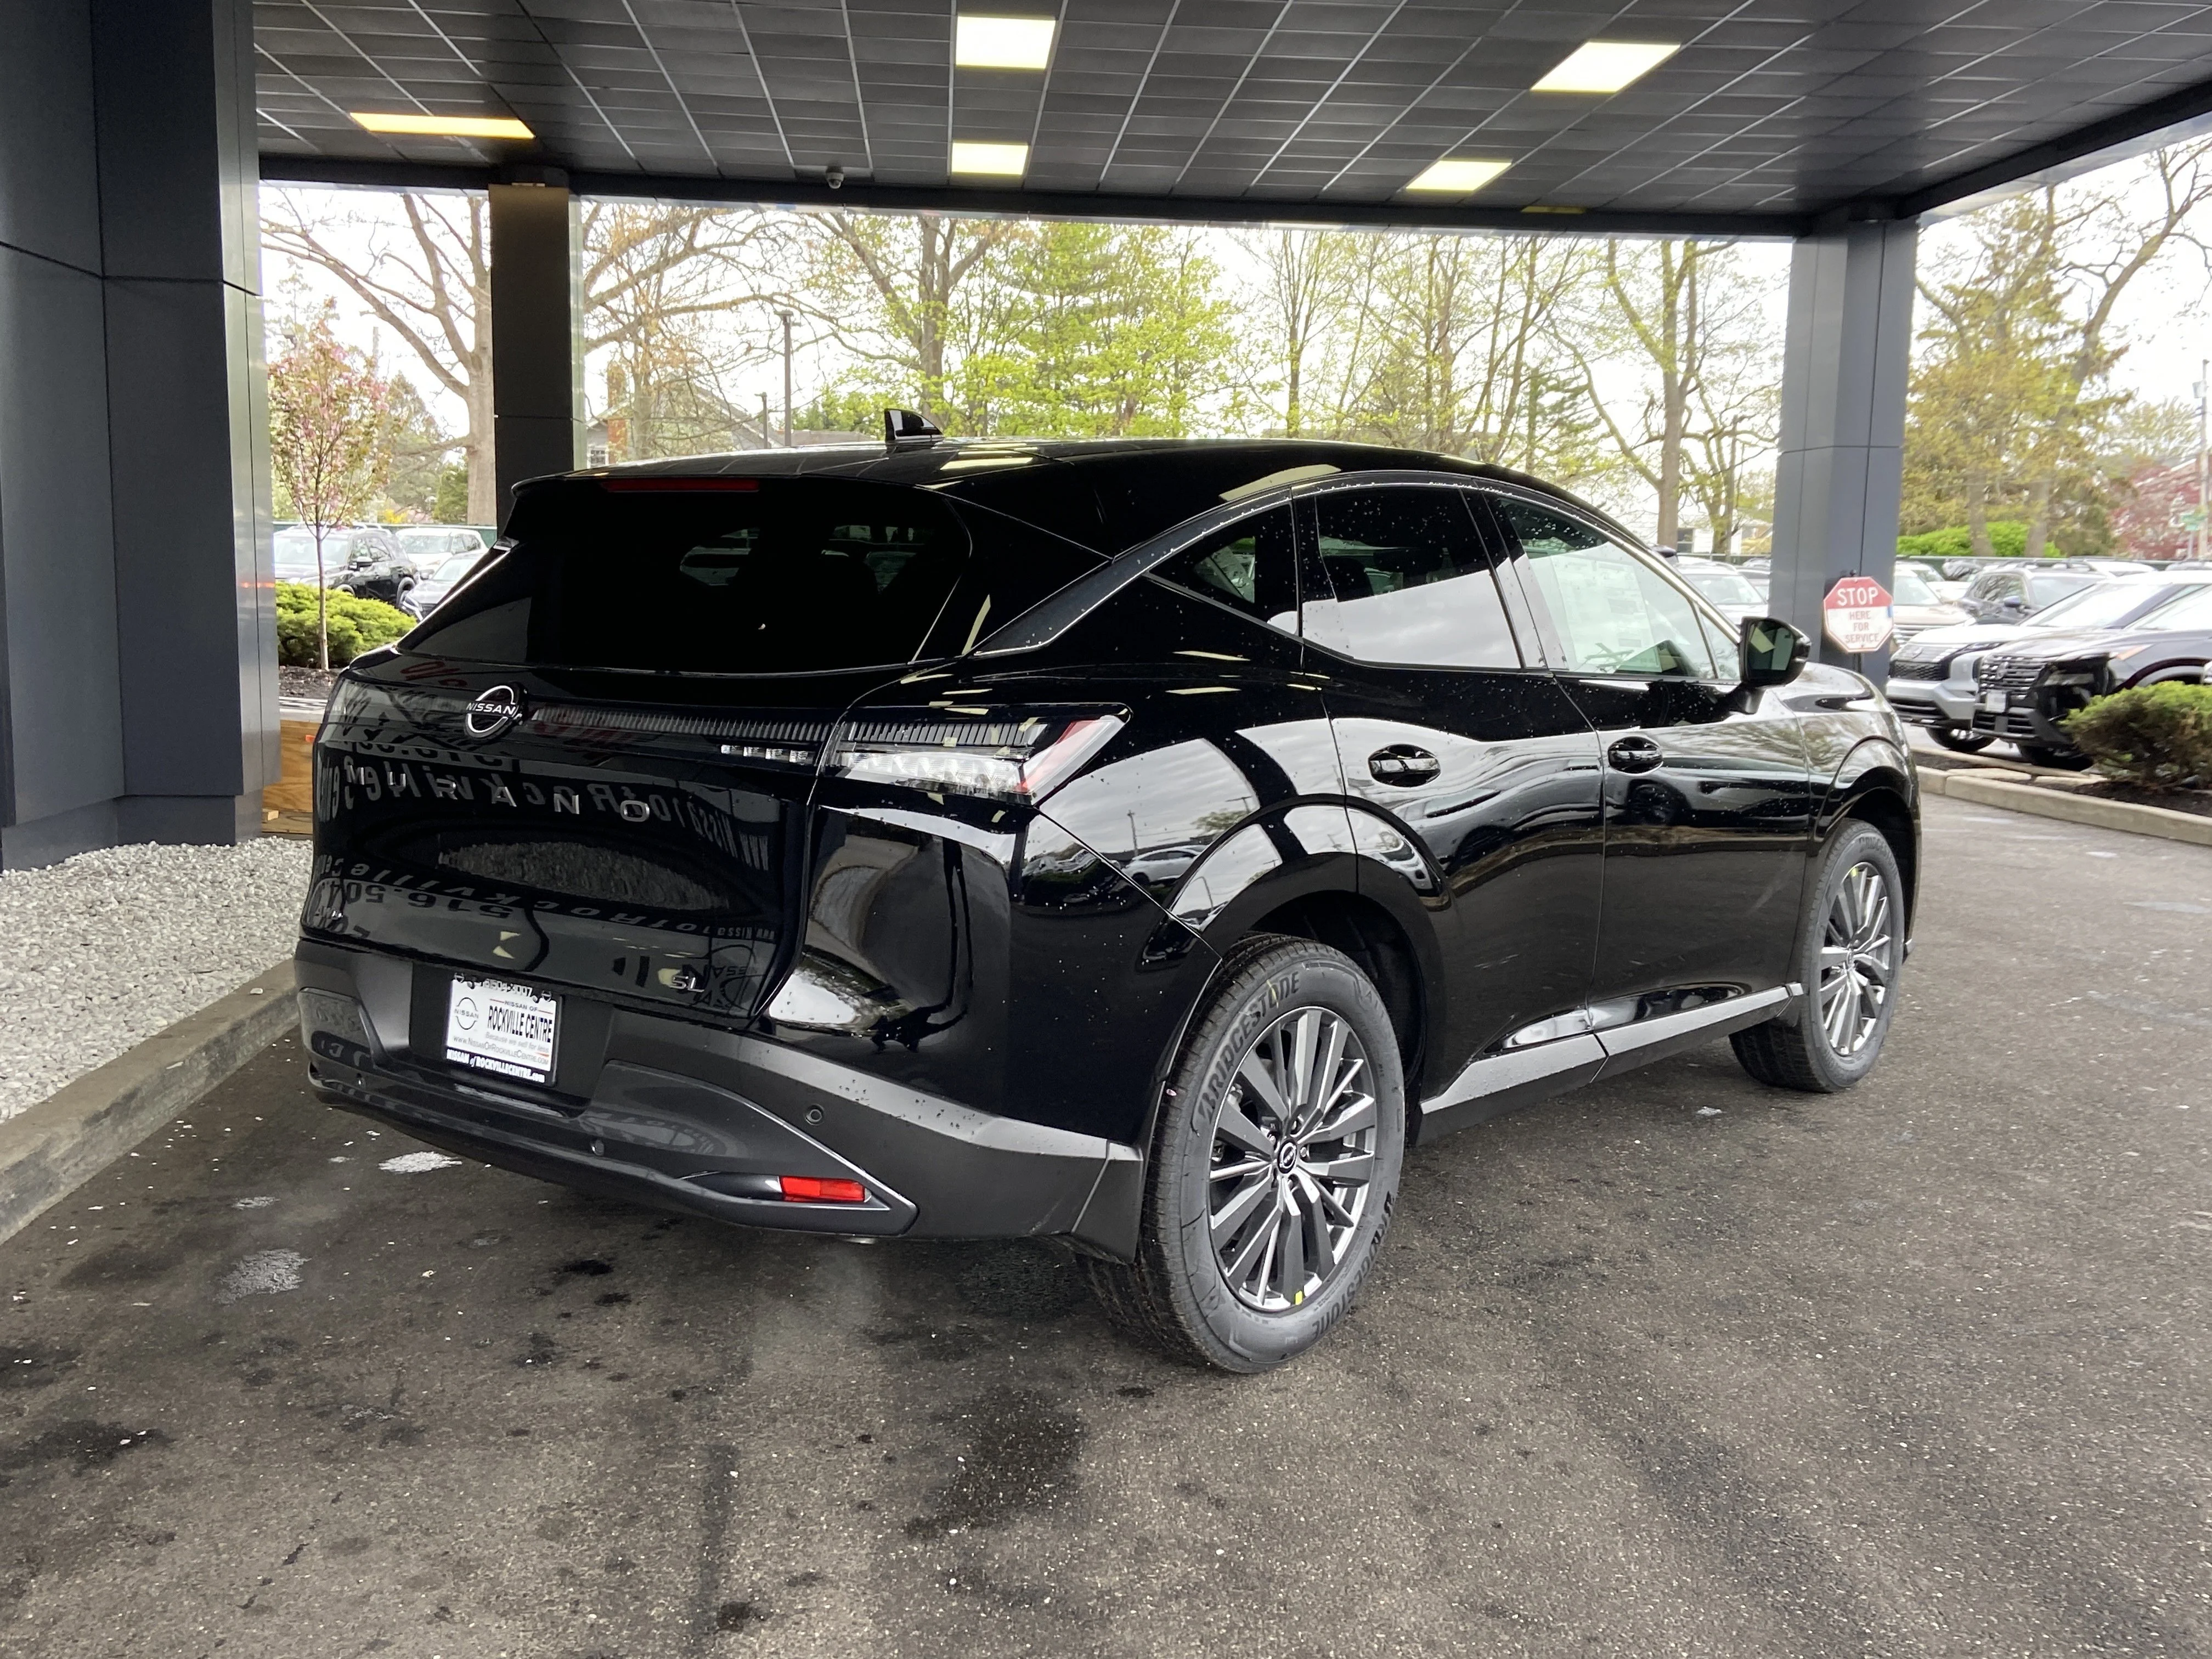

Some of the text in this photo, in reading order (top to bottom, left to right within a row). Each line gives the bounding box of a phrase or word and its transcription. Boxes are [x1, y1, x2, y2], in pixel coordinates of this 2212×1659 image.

[1837, 586, 1878, 606] STOP
[1848, 611, 1871, 620] HERE
[1853, 622, 1870, 631] FOR
[1844, 633, 1880, 644] SERVICE
[465, 702, 517, 715] NISSAN
[347, 764, 650, 822] MURANO
[670, 975, 704, 992] SL
[504, 1000, 527, 1010] NISSAN
[454, 1008, 479, 1019] NISSAN
[487, 1005, 552, 1043] ROCKVILLE CENTRE
[1198, 971, 1300, 1124] BRIDGESTONE
[447, 1048, 470, 1064] NISSAN
